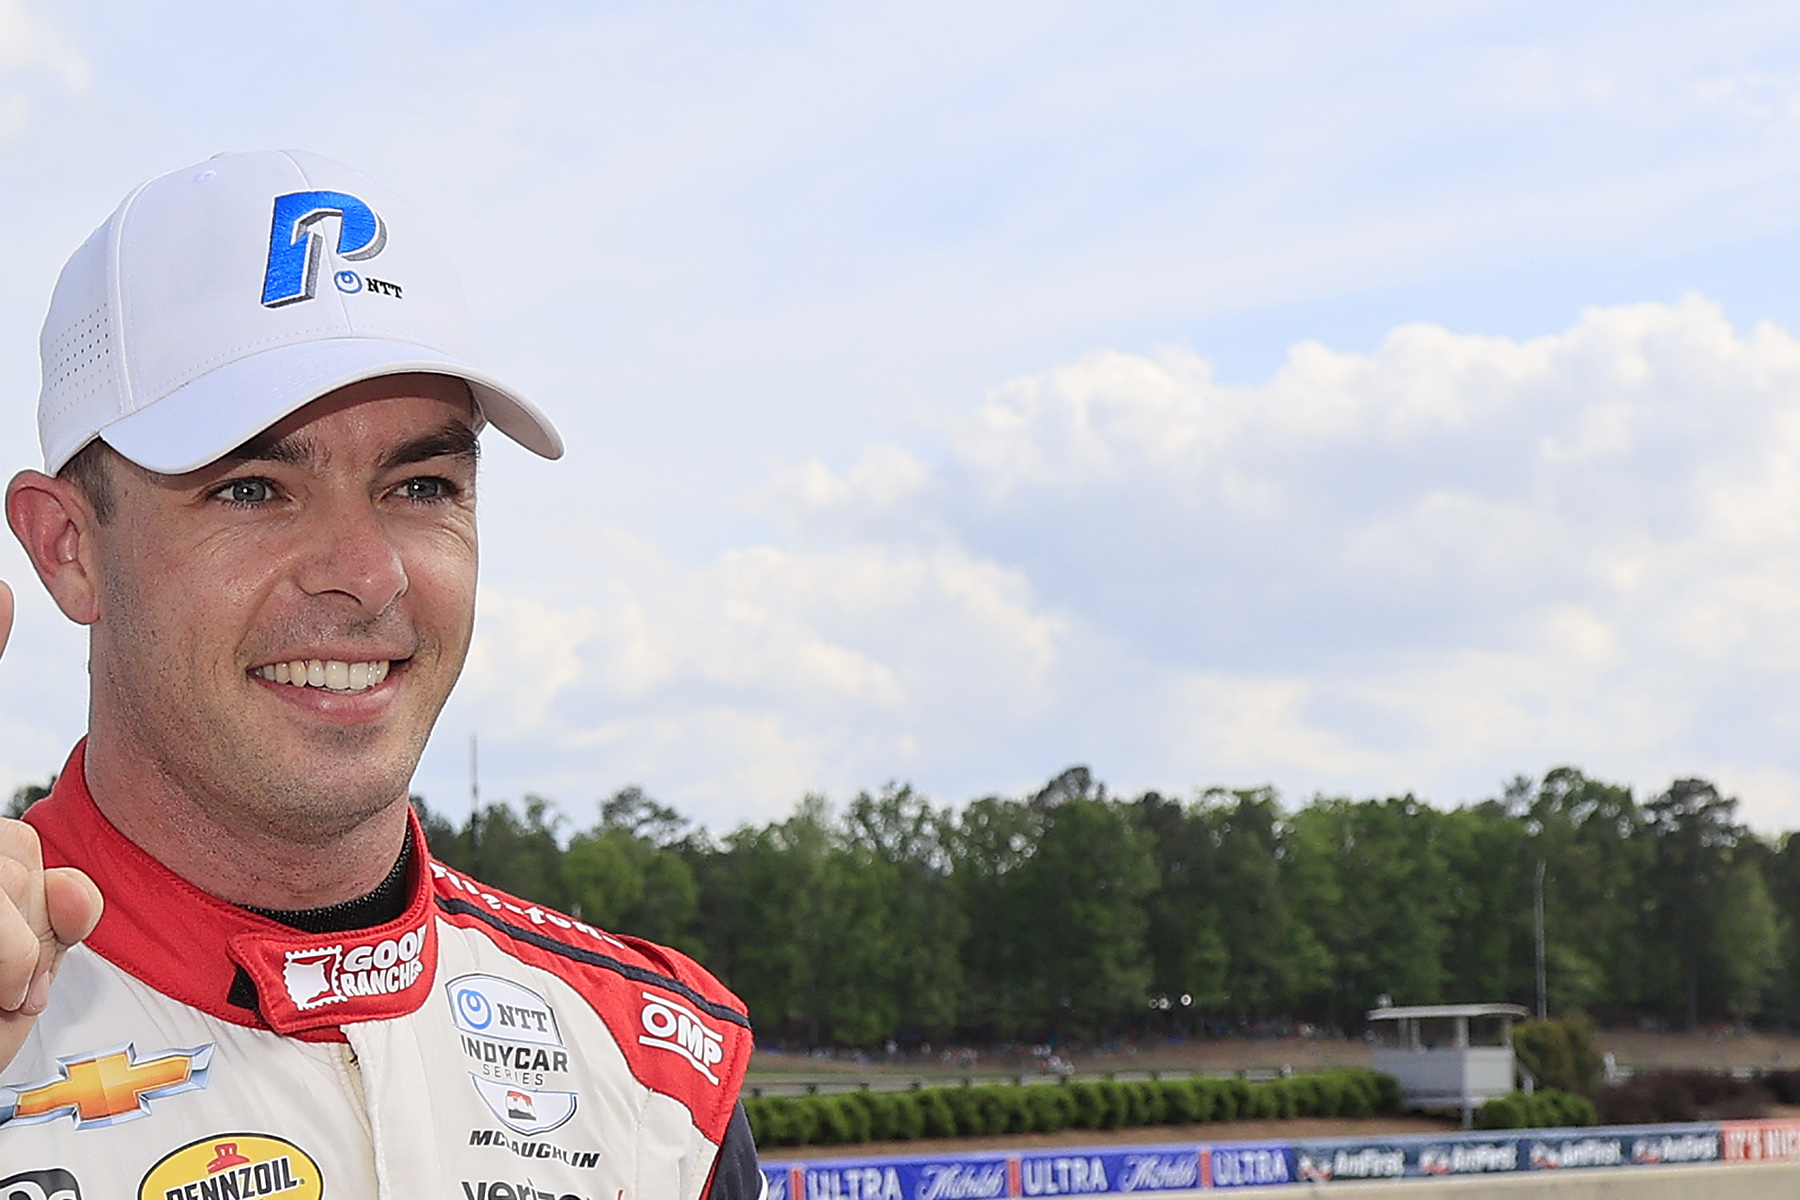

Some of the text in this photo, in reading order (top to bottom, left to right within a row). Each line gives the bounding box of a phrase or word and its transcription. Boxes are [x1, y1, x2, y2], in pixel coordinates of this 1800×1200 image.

[365, 276, 403, 300] NTT
[497, 1003, 548, 1033] NTT
[640, 1002, 724, 1068] OMP
[460, 1034, 569, 1073] INDYCAR
[482, 1063, 544, 1086] SERIES
[469, 1130, 601, 1168] MCLAUGHLIN
[1021, 1156, 1109, 1197] ULTRA
[1210, 1147, 1290, 1187] ULTRA
